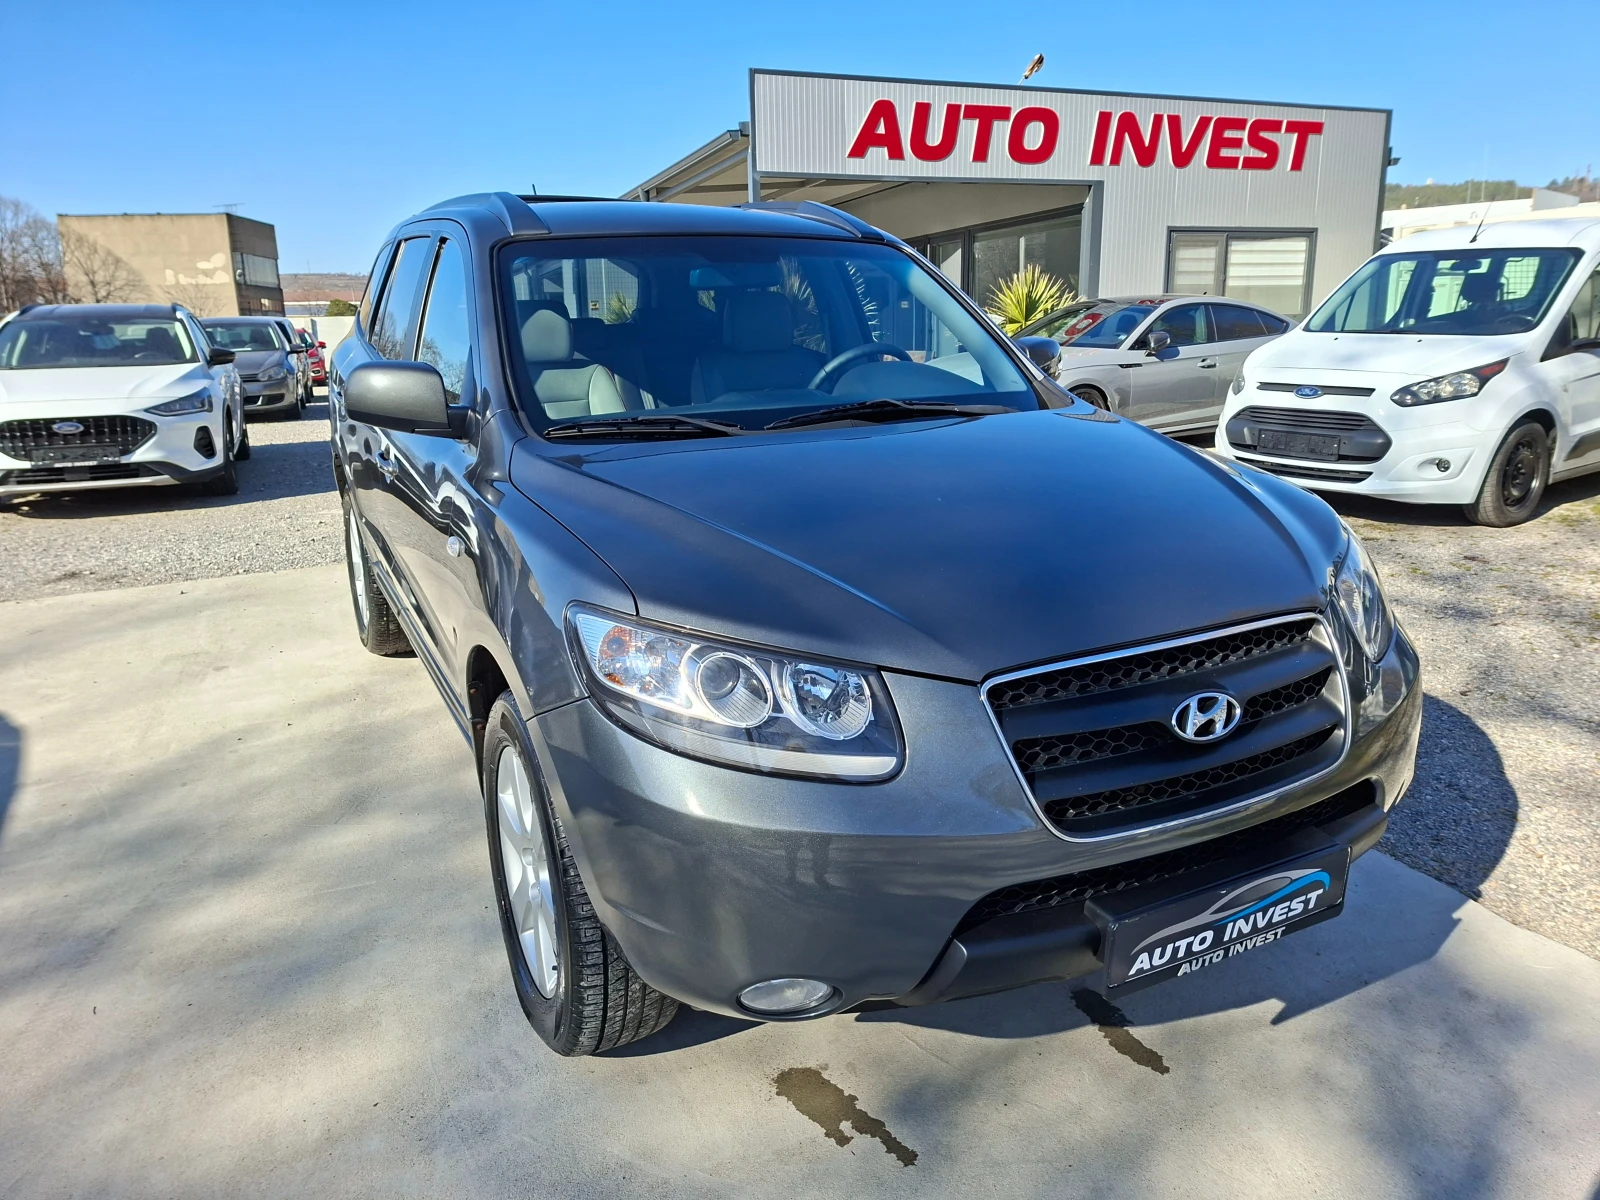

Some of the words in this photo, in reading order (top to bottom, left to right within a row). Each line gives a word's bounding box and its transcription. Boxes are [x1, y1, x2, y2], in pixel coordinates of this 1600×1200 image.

[847, 99, 1060, 166] AUTO
[1090, 110, 1324, 172] INVEST
[1128, 931, 1213, 976] AUTO
[1223, 889, 1324, 941] INVEST
[1177, 949, 1224, 977] AUTO
[1228, 927, 1286, 957] INVEST
